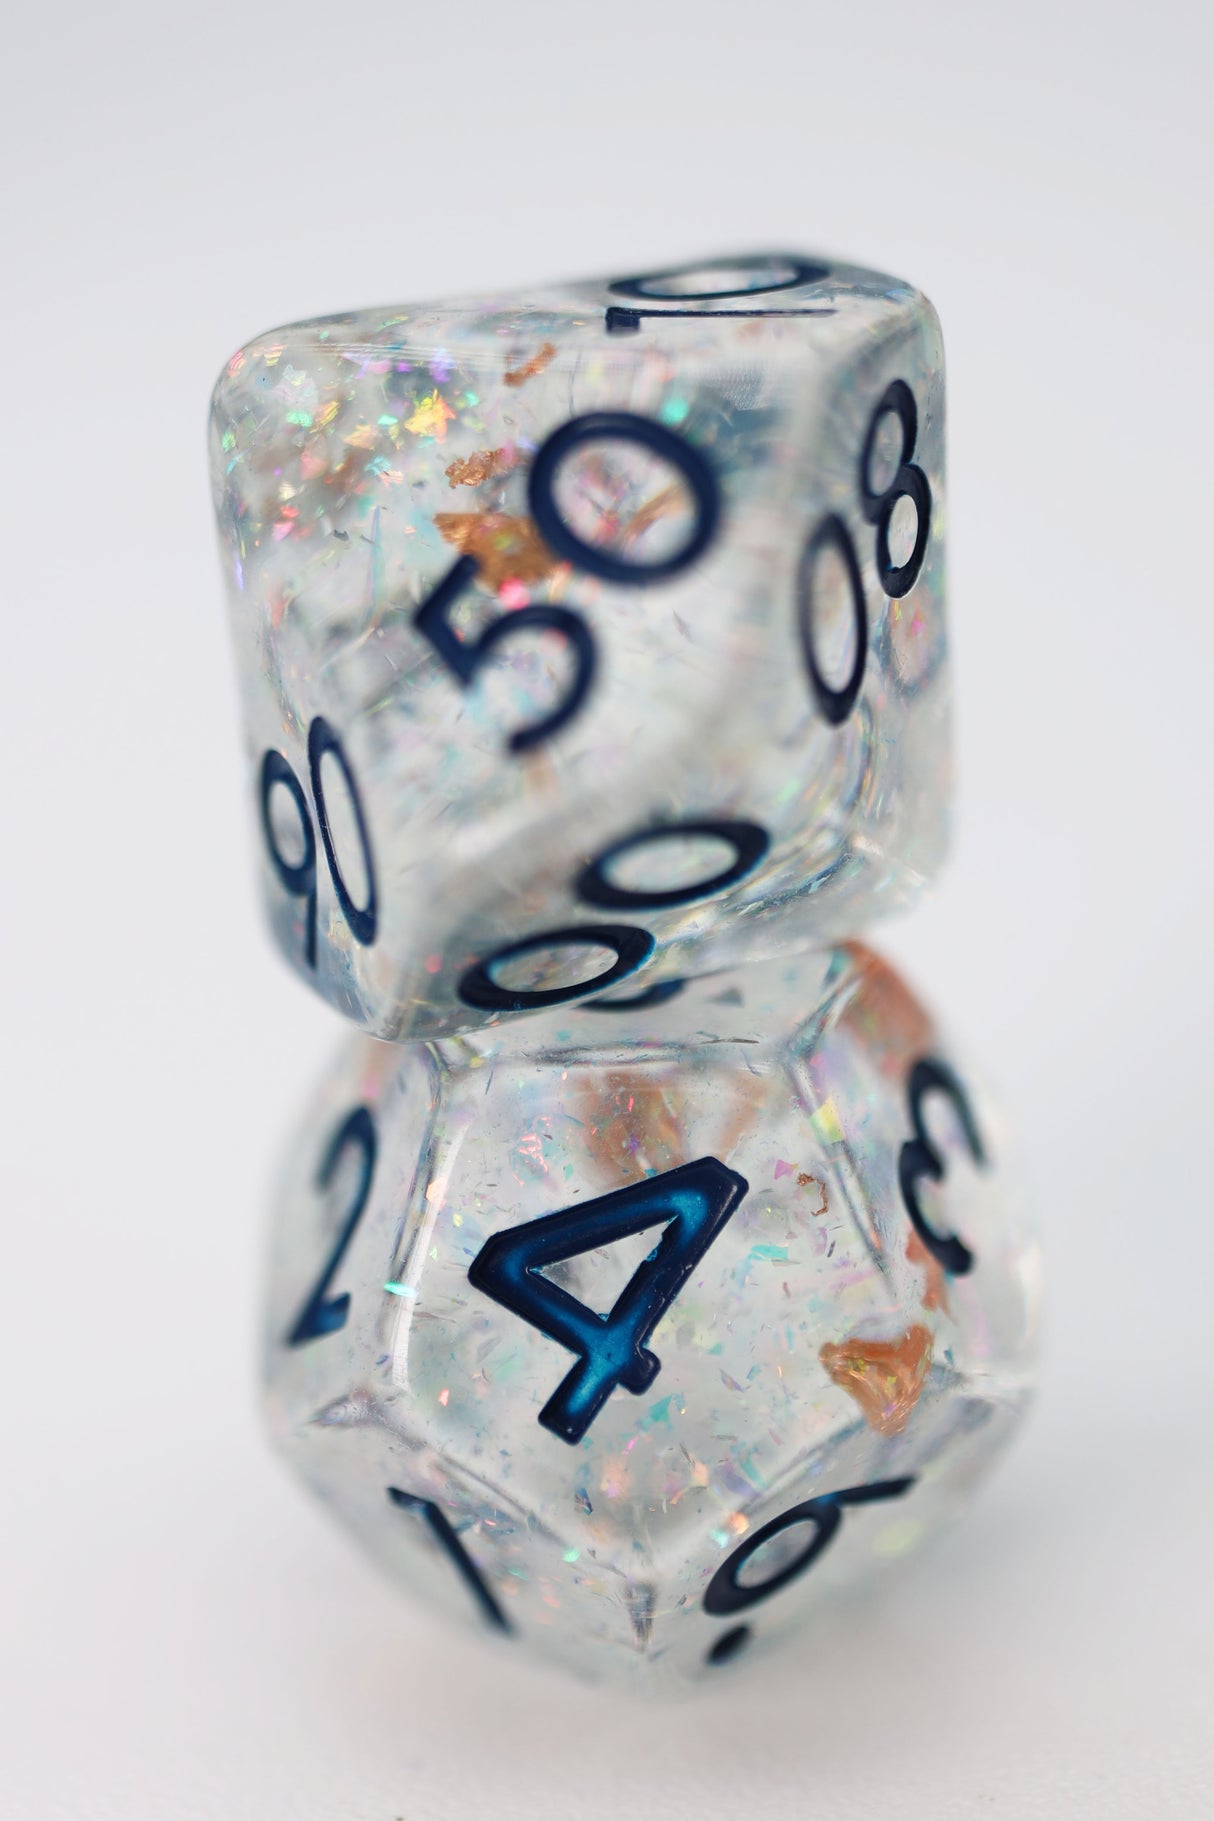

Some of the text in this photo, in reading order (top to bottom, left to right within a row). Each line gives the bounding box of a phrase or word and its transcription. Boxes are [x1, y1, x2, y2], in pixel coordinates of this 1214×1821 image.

[606, 253, 834, 334] 10
[412, 409, 723, 755] 50
[796, 378, 932, 728] 80
[259, 714, 379, 970] 90
[288, 1105, 377, 1348] 2
[897, 1056, 992, 1277] 3
[467, 1156, 749, 1446] 4
